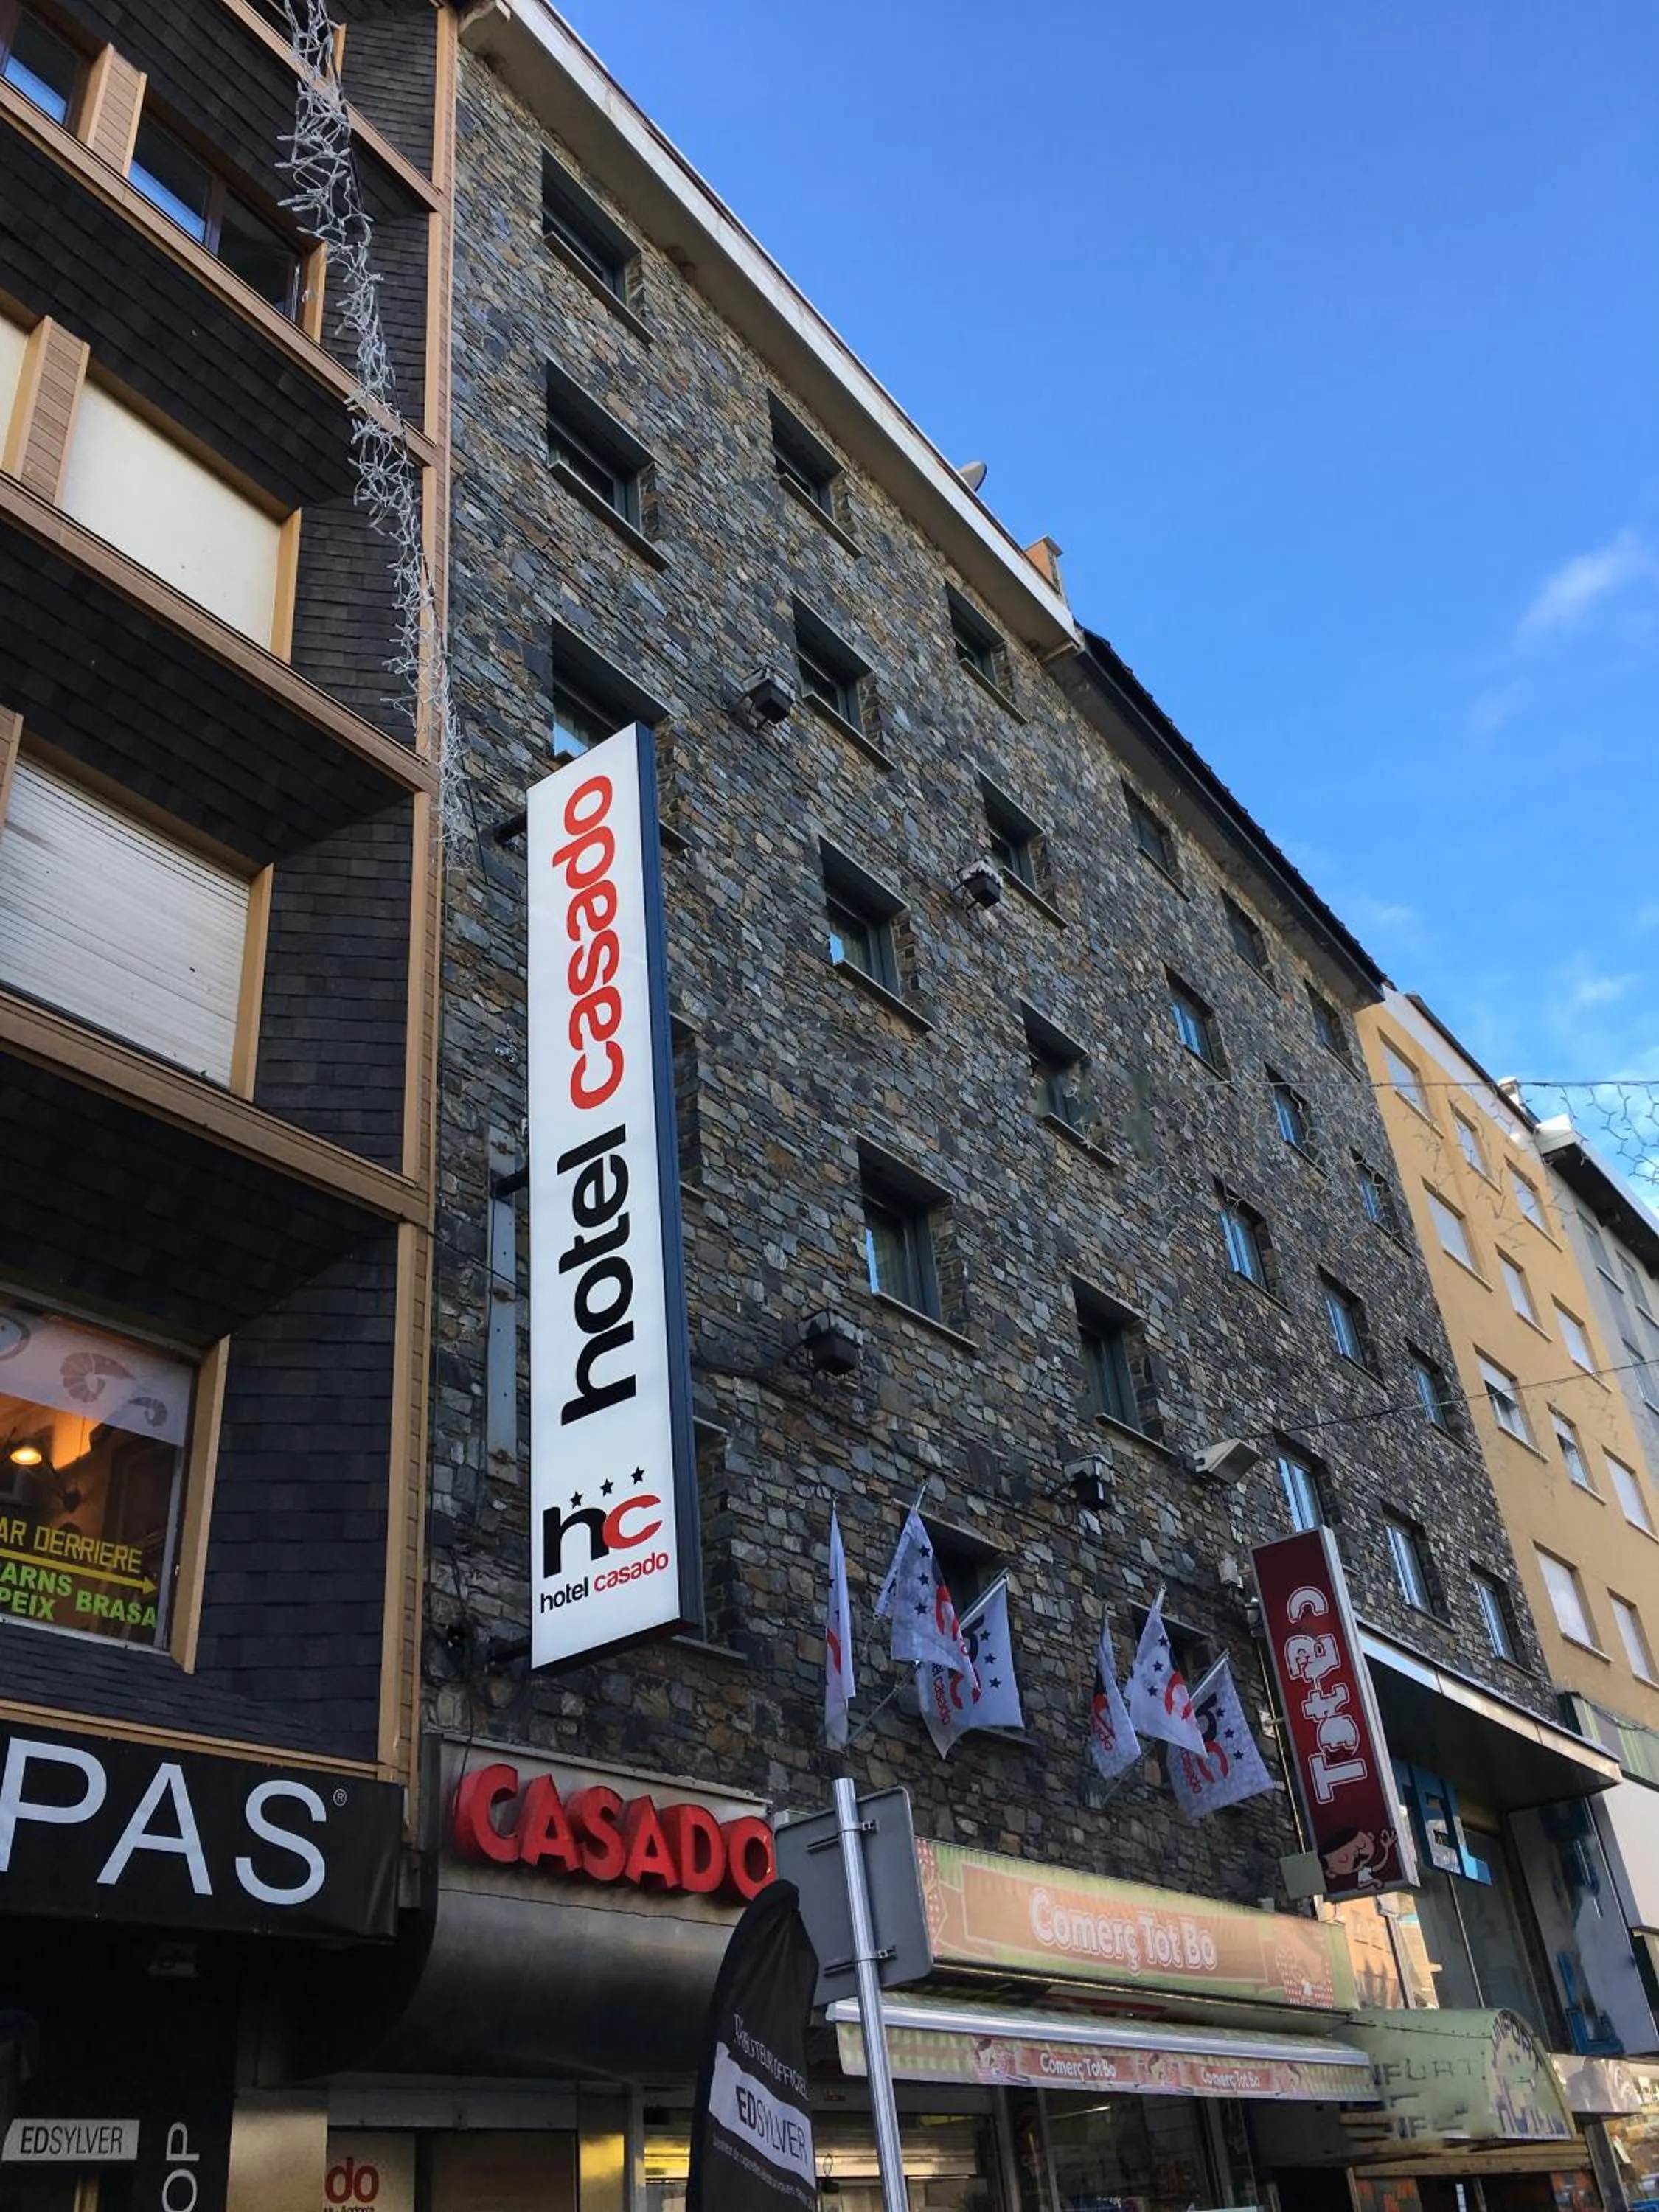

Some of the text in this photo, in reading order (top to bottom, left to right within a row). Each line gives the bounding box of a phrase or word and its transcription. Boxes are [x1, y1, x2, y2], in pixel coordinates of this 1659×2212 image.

[552, 775, 636, 1426] hotel casado
[33, 1525, 142, 1573] DERRIERE
[540, 1551, 669, 1613] hotel casado
[75, 1590, 157, 1628] BRASA
[0, 1736, 327, 1905] PAS
[454, 1763, 776, 1901] CASADO
[1030, 1888, 1217, 1977] Comerç Tot Bo
[20, 2127, 122, 2154] EDSYLVER
[736, 2084, 809, 2166] EDSYLVER
